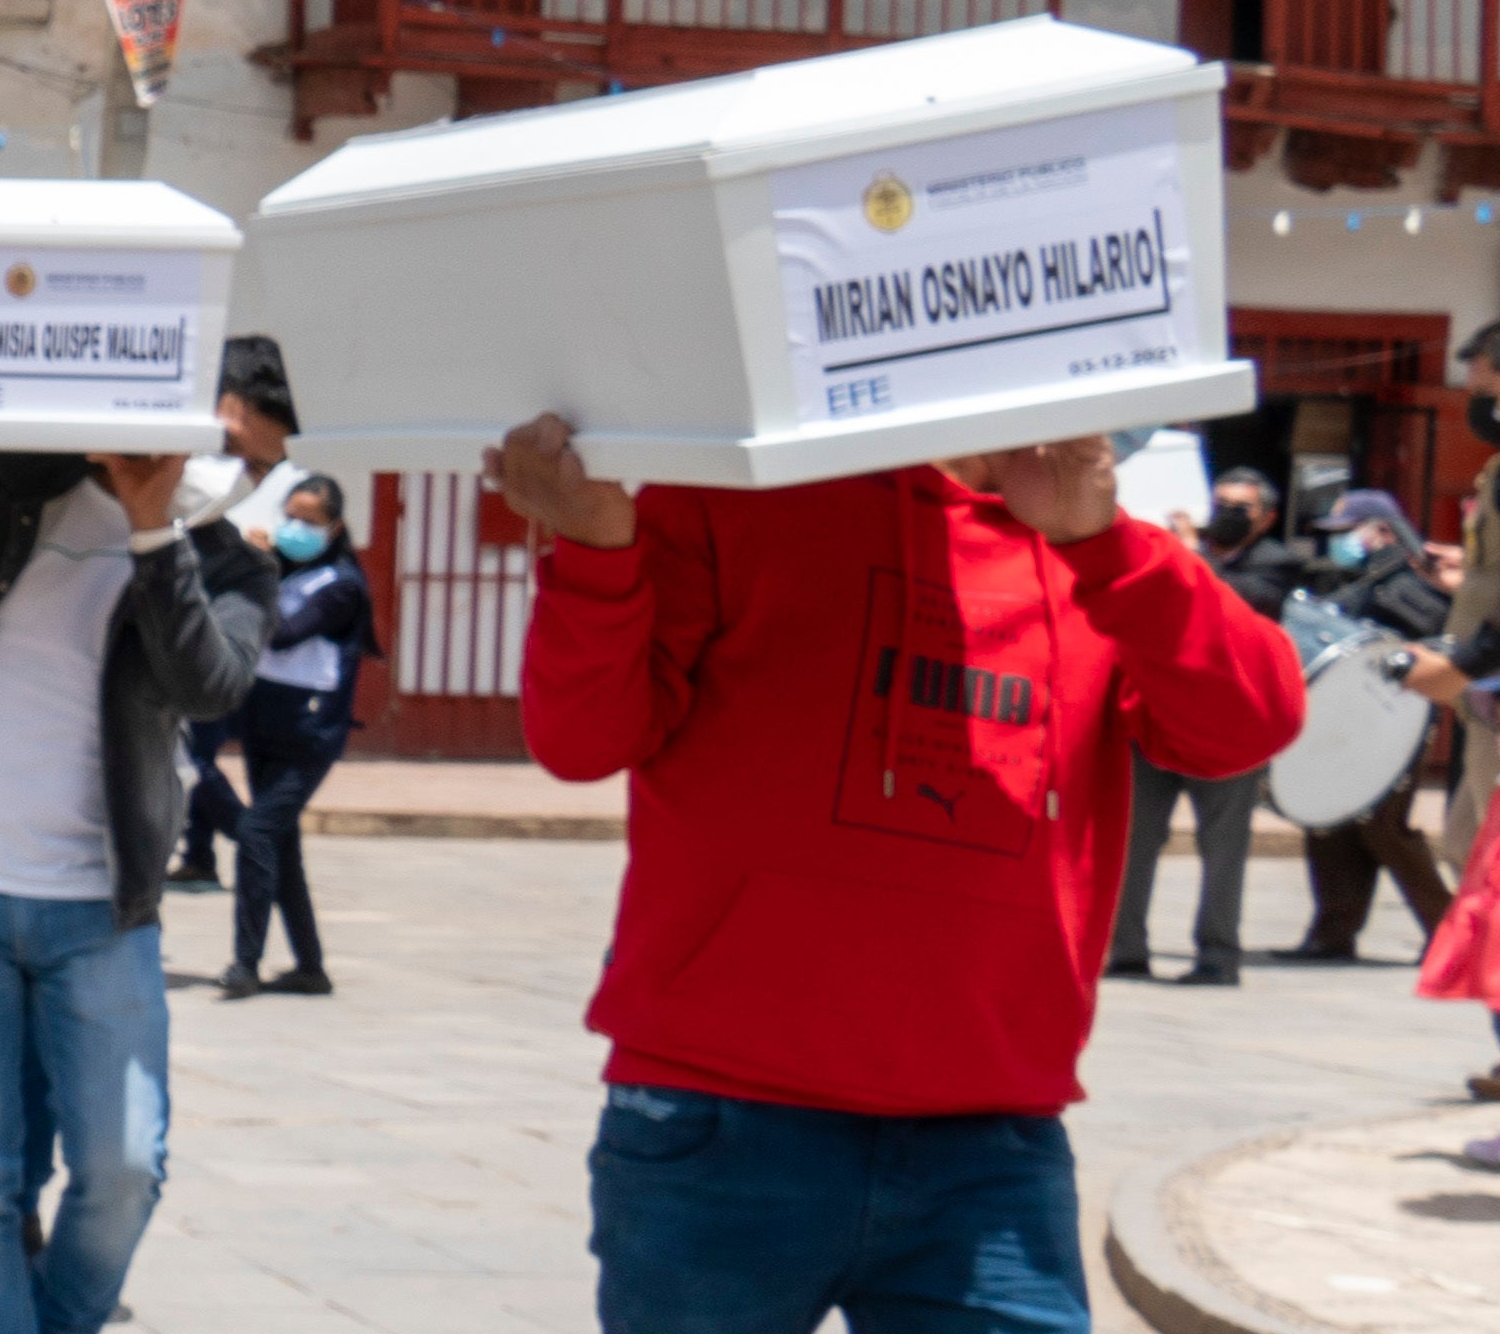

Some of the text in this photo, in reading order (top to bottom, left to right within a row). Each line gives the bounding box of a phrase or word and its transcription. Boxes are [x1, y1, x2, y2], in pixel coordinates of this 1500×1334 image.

[814, 227, 1156, 344] MIRIAN OSNAYO HILARIO
[41, 323, 101, 363] QUISPE
[106, 323, 179, 365] MALLQUI
[1067, 346, 1179, 376] 03-12-2021
[825, 374, 891, 420] EFE
